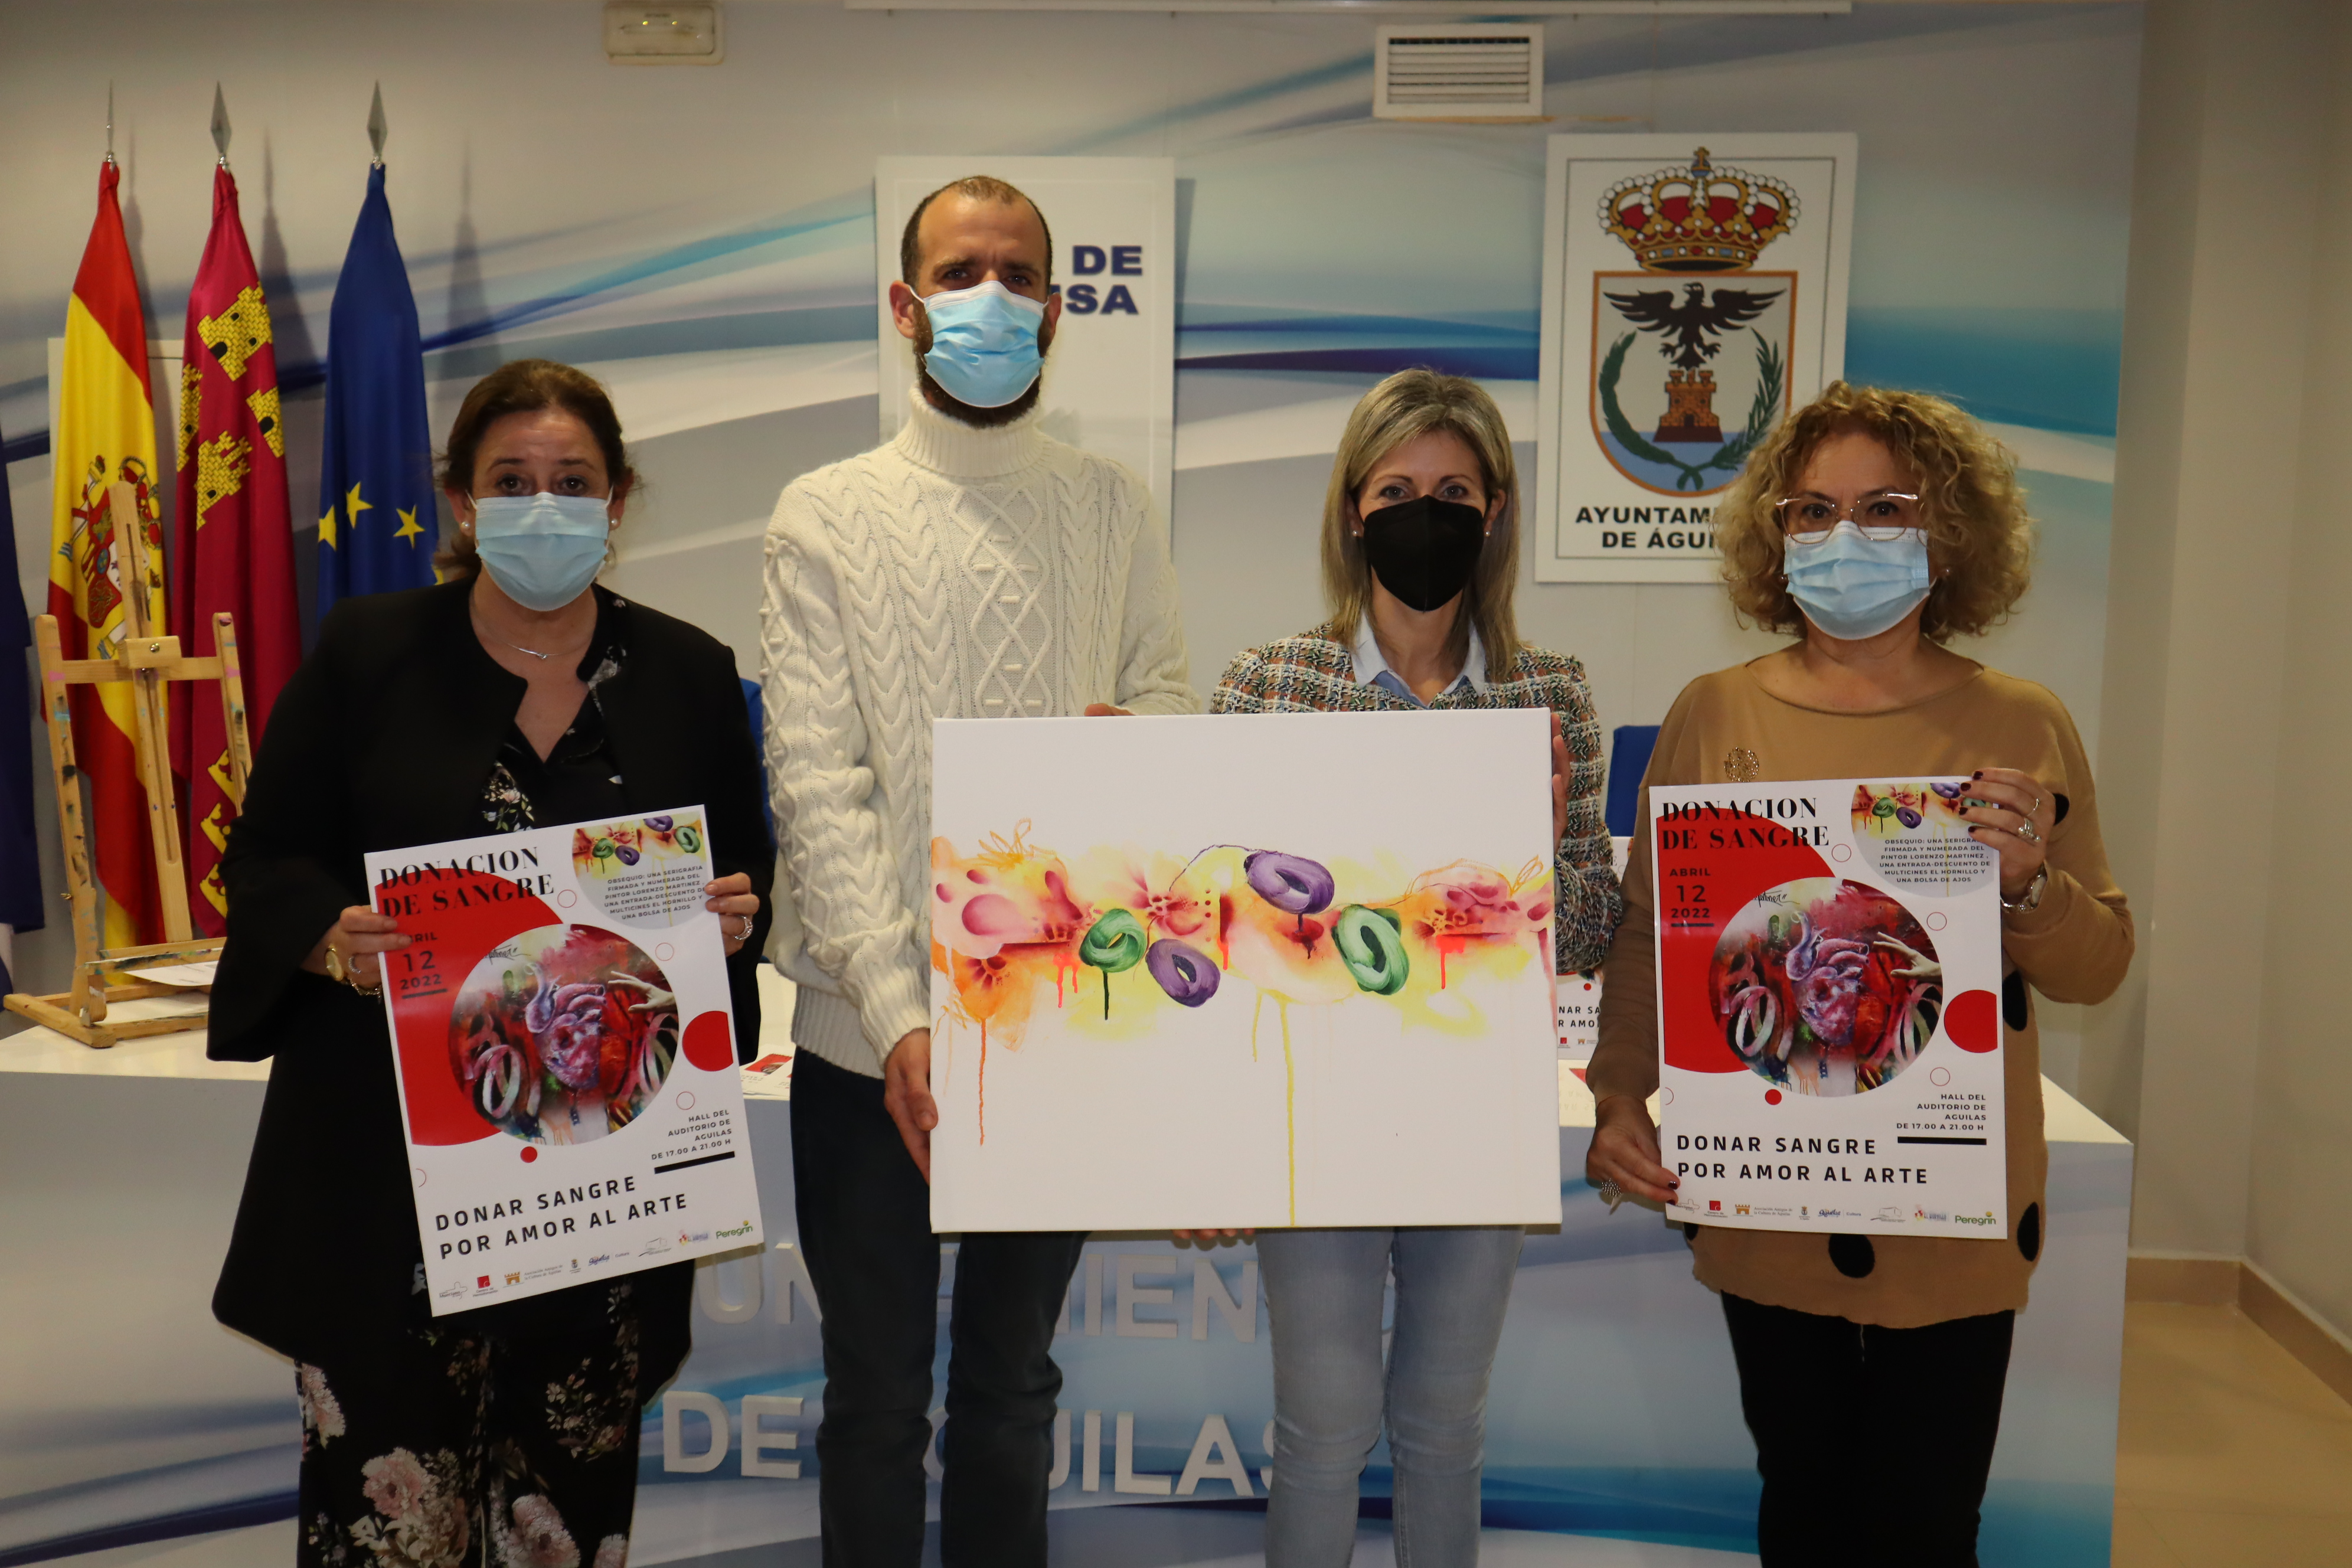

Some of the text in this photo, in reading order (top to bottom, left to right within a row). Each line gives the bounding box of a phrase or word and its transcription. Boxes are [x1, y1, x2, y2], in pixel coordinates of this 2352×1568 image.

[1073, 245, 1142, 276] DE
[1575, 507, 1716, 524] AYUNTAM
[1602, 527, 1714, 548] DE ÁGUI
[1662, 798, 1817, 822] DONACION
[1662, 825, 1829, 850] DE SANGRE
[379, 847, 538, 890] DONACION
[607, 875, 645, 884] OBSEQUIO:
[663, 865, 703, 876] SERIGRAFIA
[1670, 868, 1711, 877] ABRIL
[605, 881, 701, 900] PINTOR LORENZO MARTINEZ
[607, 883, 639, 891] FIRMADA
[647, 876, 685, 886] NUMERADA
[383, 874, 554, 918] DE SANGRE
[621, 888, 695, 904] ENTRADA-DESCUENTO
[1677, 885, 1706, 903] 12
[610, 904, 650, 914] MULTICINES
[662, 896, 696, 906] HORNILLO
[1671, 908, 1710, 918] 2022
[403, 950, 436, 972] 12
[400, 974, 442, 990] 2022
[688, 1109, 729, 1122] HALL DEL
[668, 1122, 716, 1137] AUDITORIO
[694, 1128, 732, 1141] AGUILAS
[665, 1148, 688, 1157] 17.00
[700, 1140, 722, 1150] 21.00
[1677, 1135, 1876, 1155] DONAR SANGRE
[1678, 1162, 1928, 1184] POR AMOR AL ARTE
[436, 1176, 636, 1231] DONAR SANGRE
[440, 1194, 687, 1259] POR AMOR AL ARTE
[662, 1390, 805, 1479] DE
